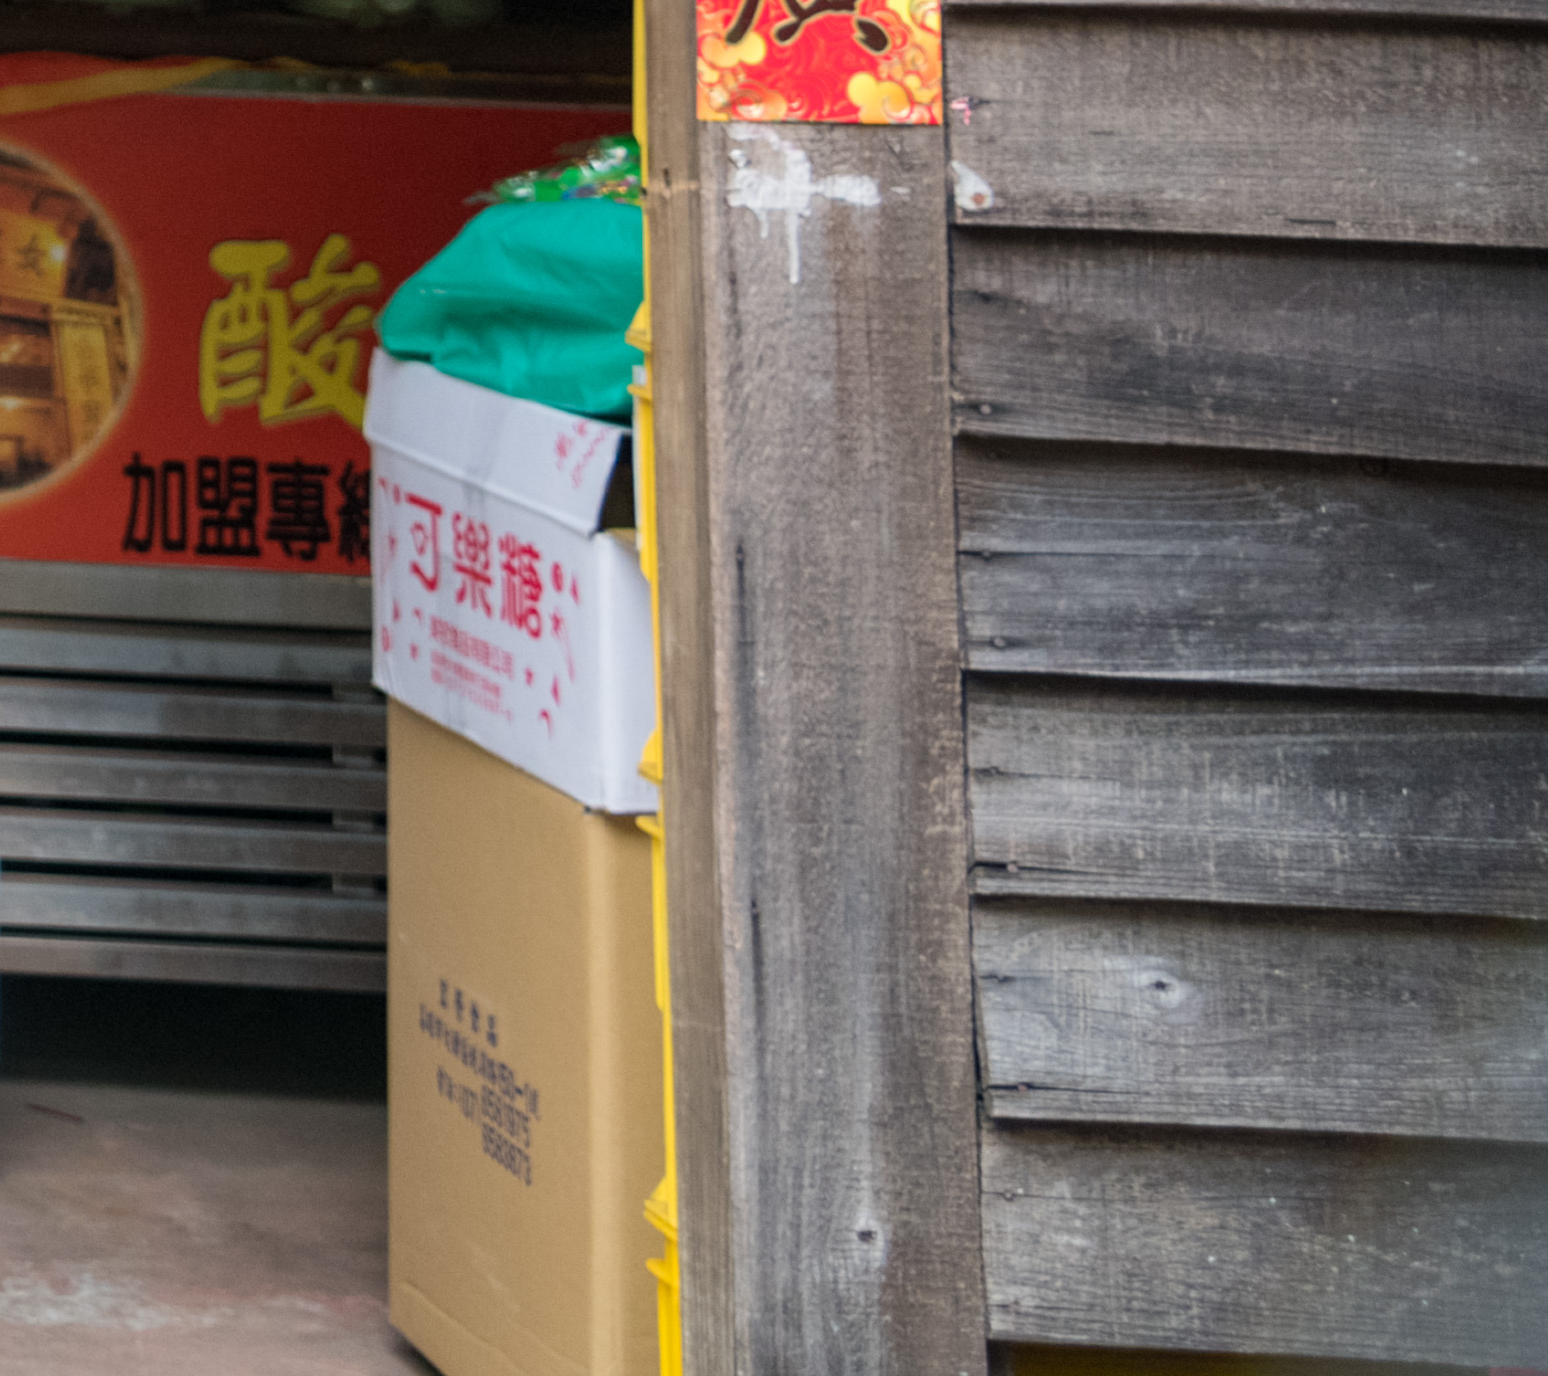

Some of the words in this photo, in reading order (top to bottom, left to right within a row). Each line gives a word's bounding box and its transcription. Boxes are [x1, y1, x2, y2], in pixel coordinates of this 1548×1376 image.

[198, 234, 381, 429] 酸
[405, 492, 542, 639] 可樂糖
